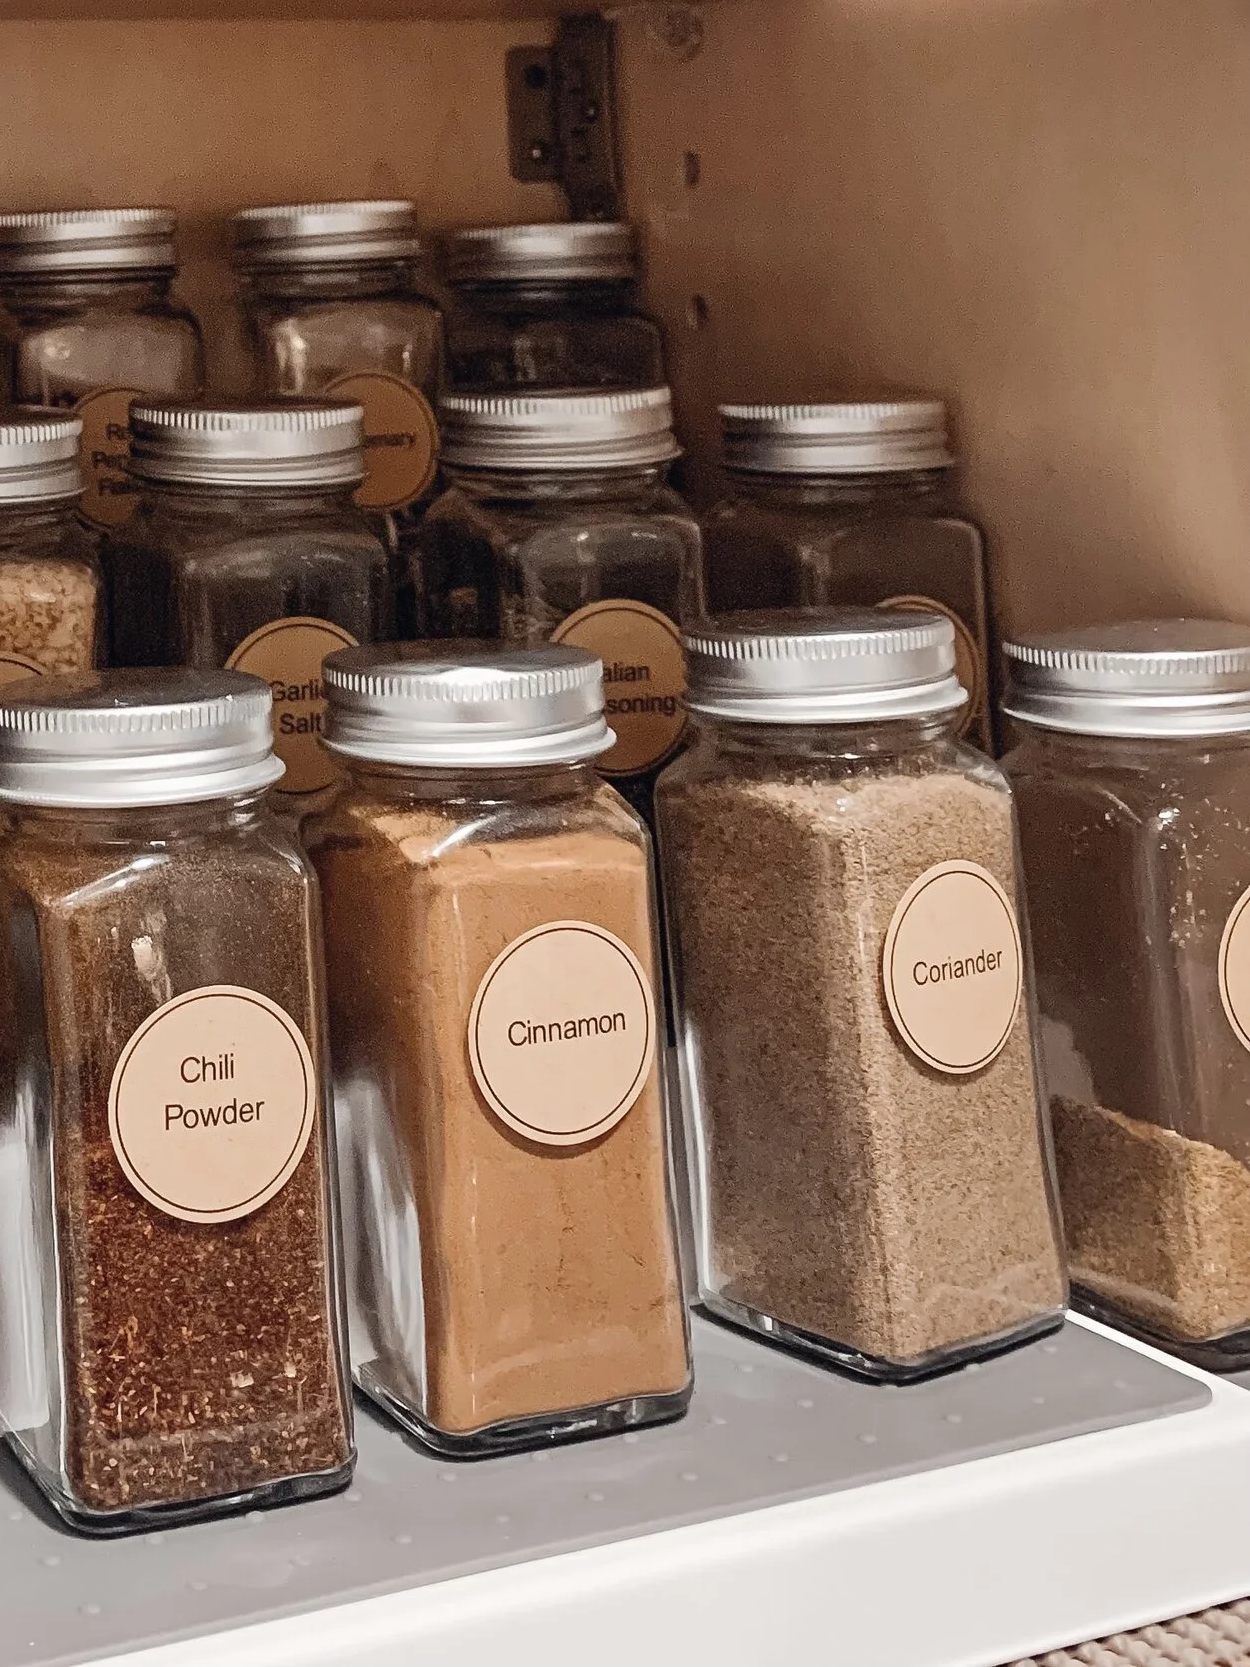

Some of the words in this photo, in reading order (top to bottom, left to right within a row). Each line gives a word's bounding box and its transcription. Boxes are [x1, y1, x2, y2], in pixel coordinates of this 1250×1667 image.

[270, 678, 323, 702] Garli
[279, 712, 322, 735] Salt
[912, 948, 1003, 986] Coriander
[508, 1011, 627, 1047] Cinnamon
[180, 1052, 235, 1084] Chili
[165, 1097, 266, 1131] Powder
